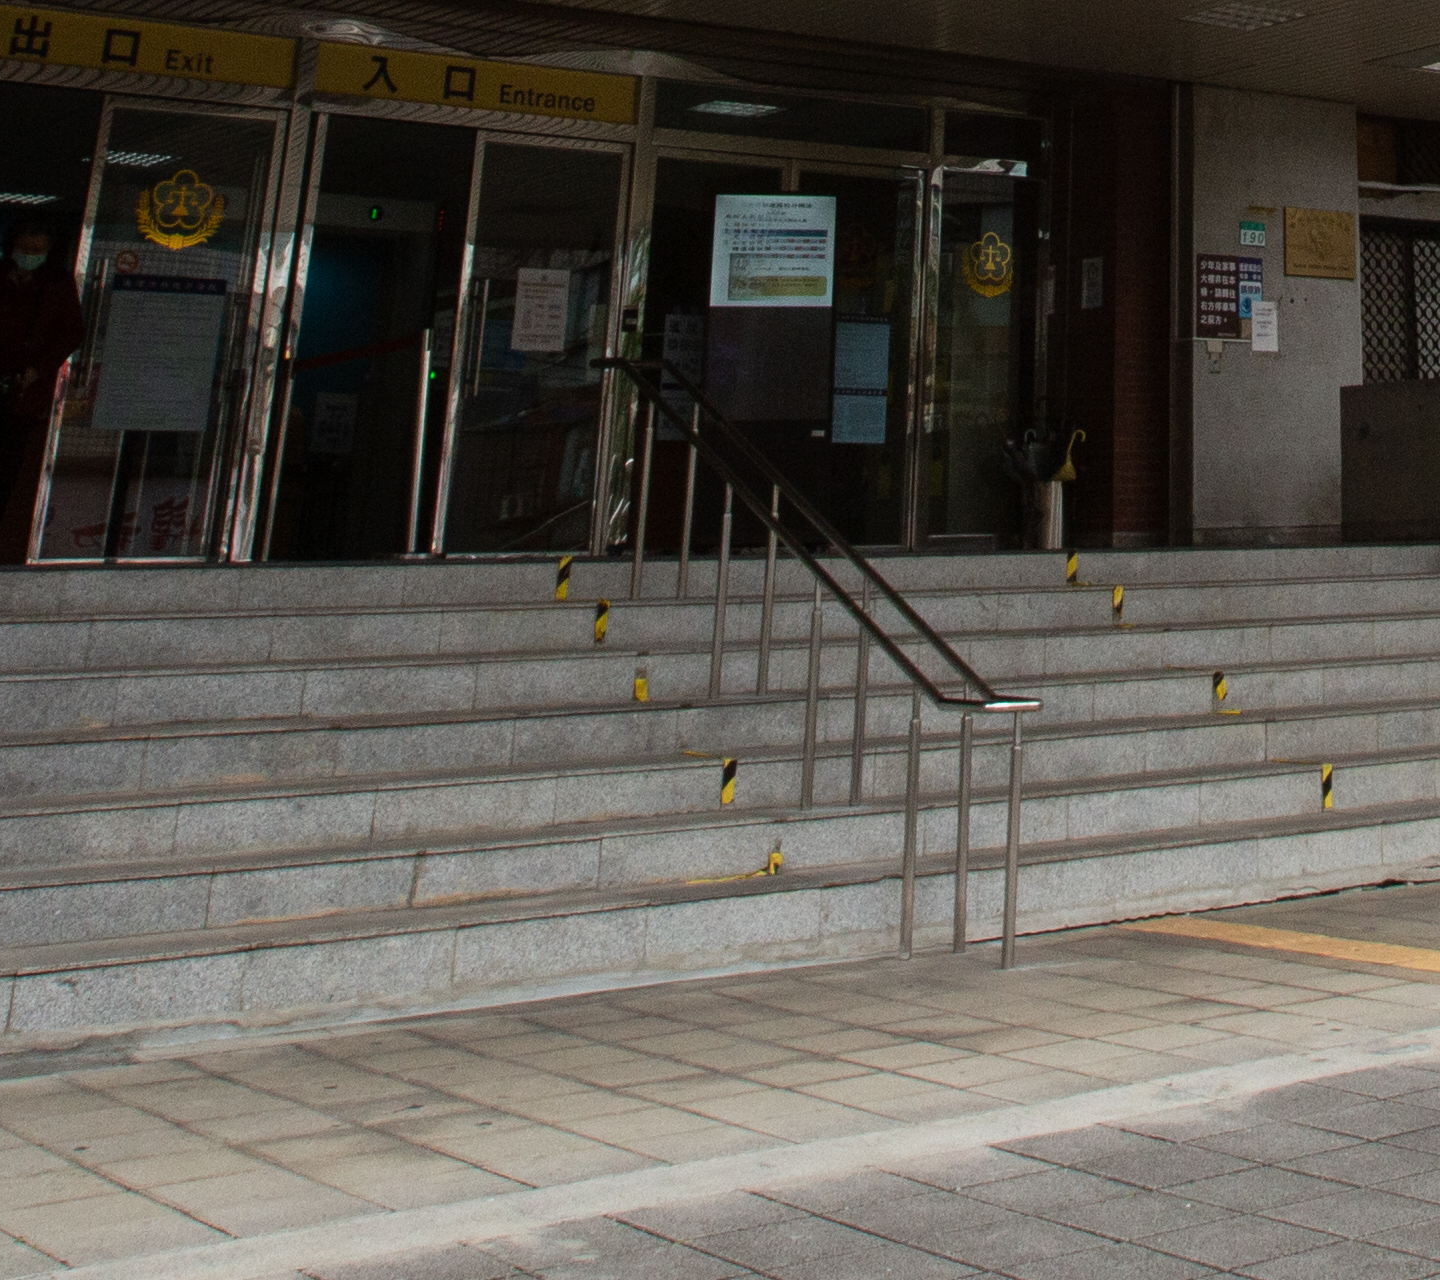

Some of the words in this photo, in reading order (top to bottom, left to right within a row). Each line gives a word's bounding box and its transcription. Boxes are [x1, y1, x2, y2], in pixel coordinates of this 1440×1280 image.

[9, 16, 140, 67] 出口
[165, 49, 214, 74] Exit
[363, 56, 476, 101] 入口
[499, 84, 597, 113] Entrance
[1242, 232, 1264, 244] 190
